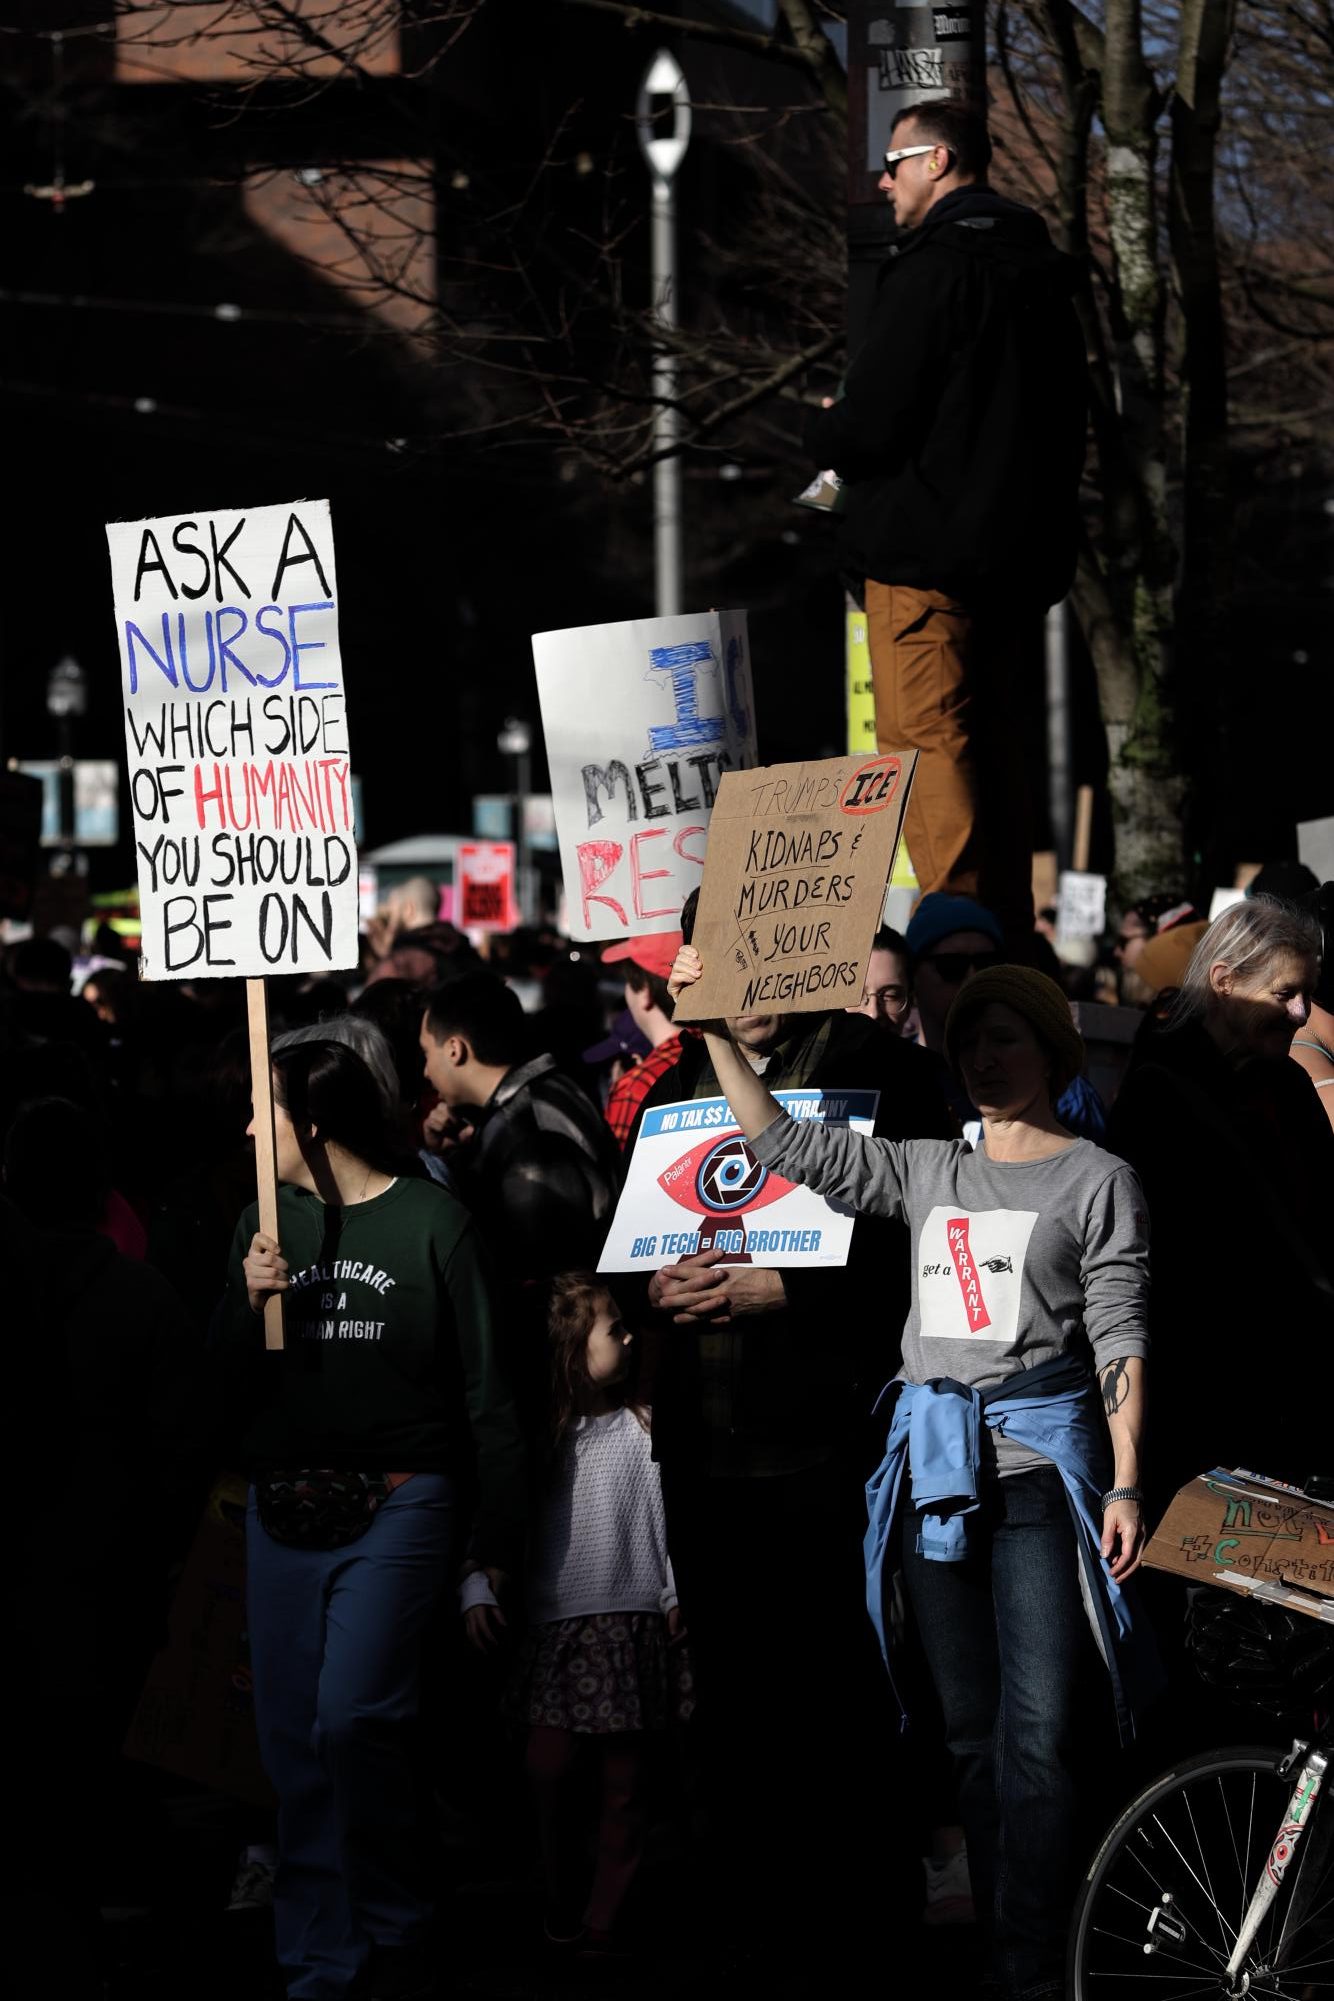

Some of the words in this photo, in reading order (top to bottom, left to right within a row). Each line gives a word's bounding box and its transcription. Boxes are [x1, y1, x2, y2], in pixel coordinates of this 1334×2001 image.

[134, 517, 251, 602] ASK
[271, 512, 332, 602] A
[125, 601, 338, 694] NURSE
[127, 697, 253, 759] WHICH
[263, 694, 348, 756] SIDE
[132, 765, 185, 824] OF
[193, 758, 349, 834] HUMANITY
[845, 770, 898, 807] ICE
[137, 834, 200, 893] YOU
[211, 832, 351, 887] SHOULD
[745, 829, 842, 873] KIDNAPS
[737, 874, 855, 918] MURDERS
[163, 893, 236, 971] BE
[259, 890, 333, 964] ON
[764, 921, 831, 962] YOUR
[741, 961, 859, 1011] NEIGHBORS
[660, 1111, 678, 1131] NO
[680, 1108, 703, 1128] TAX
[704, 1106, 724, 1126] $$
[786, 1099, 849, 1118] TYRANNY
[663, 1157, 694, 1187] Palantir
[630, 1236, 656, 1258] BIG
[660, 1231, 701, 1255] TECH
[701, 1237, 712, 1250] =
[713, 1229, 744, 1253] BIG
[746, 1230, 822, 1253] BROTHER
[288, 1259, 396, 1296] HEALTHCARE
[923, 1263, 941, 1278] get
[943, 1265, 951, 1276] a
[949, 1227, 982, 1322] WARRANT
[321, 1291, 334, 1310] IS
[337, 1291, 347, 1310] A
[338, 1319, 386, 1340] RIGHT
